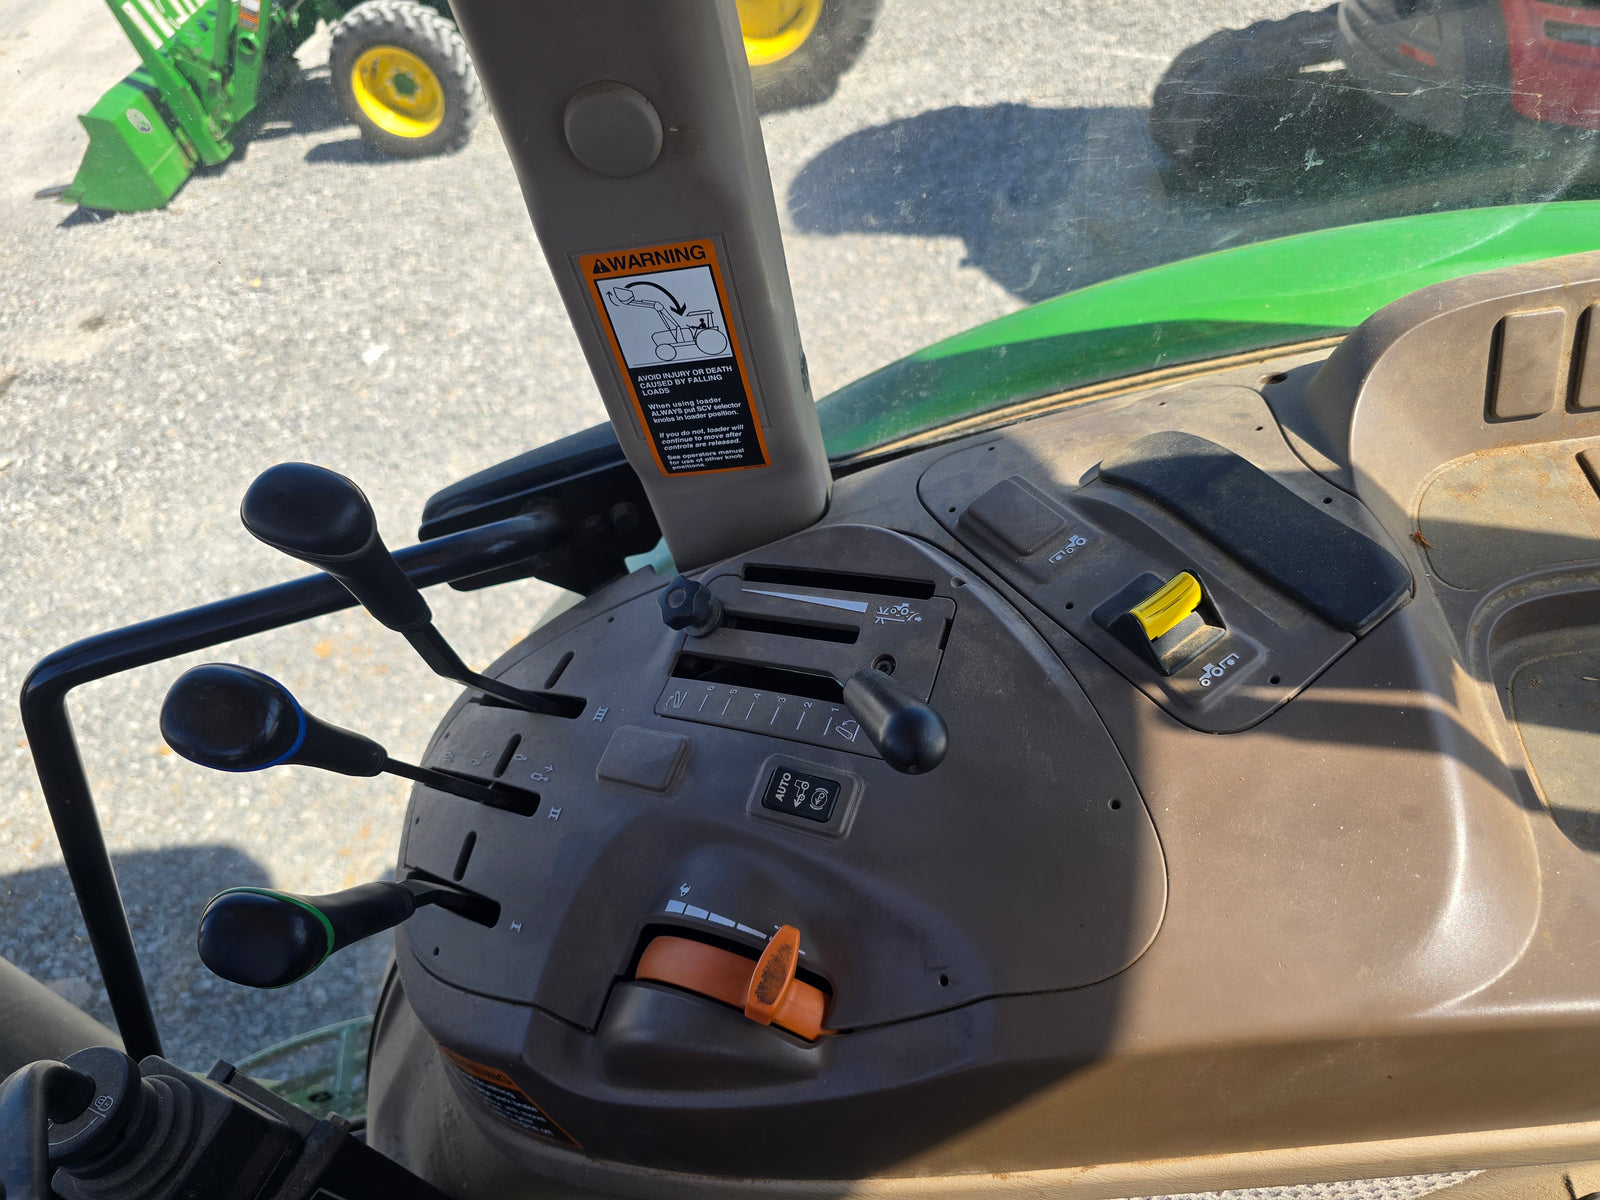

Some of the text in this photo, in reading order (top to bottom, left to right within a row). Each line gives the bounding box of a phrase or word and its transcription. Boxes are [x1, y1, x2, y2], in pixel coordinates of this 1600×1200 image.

[607, 245, 706, 271] WARNING
[637, 365, 733, 382] AVOID INJURY OR DEATH
[640, 380, 673, 389] CAUSED
[688, 374, 723, 384] FALLING
[642, 388, 670, 396] LOADS
[648, 402, 670, 410] When
[672, 400, 694, 408] using
[651, 408, 682, 417] ALWAYS
[714, 402, 741, 410] selector
[684, 412, 706, 420] loader
[708, 410, 739, 418] position.
[707, 426, 730, 434] loader
[664, 442, 694, 450] controls
[708, 438, 741, 446] released.
[718, 448, 744, 456] manual
[775, 772, 792, 802] AUTO
